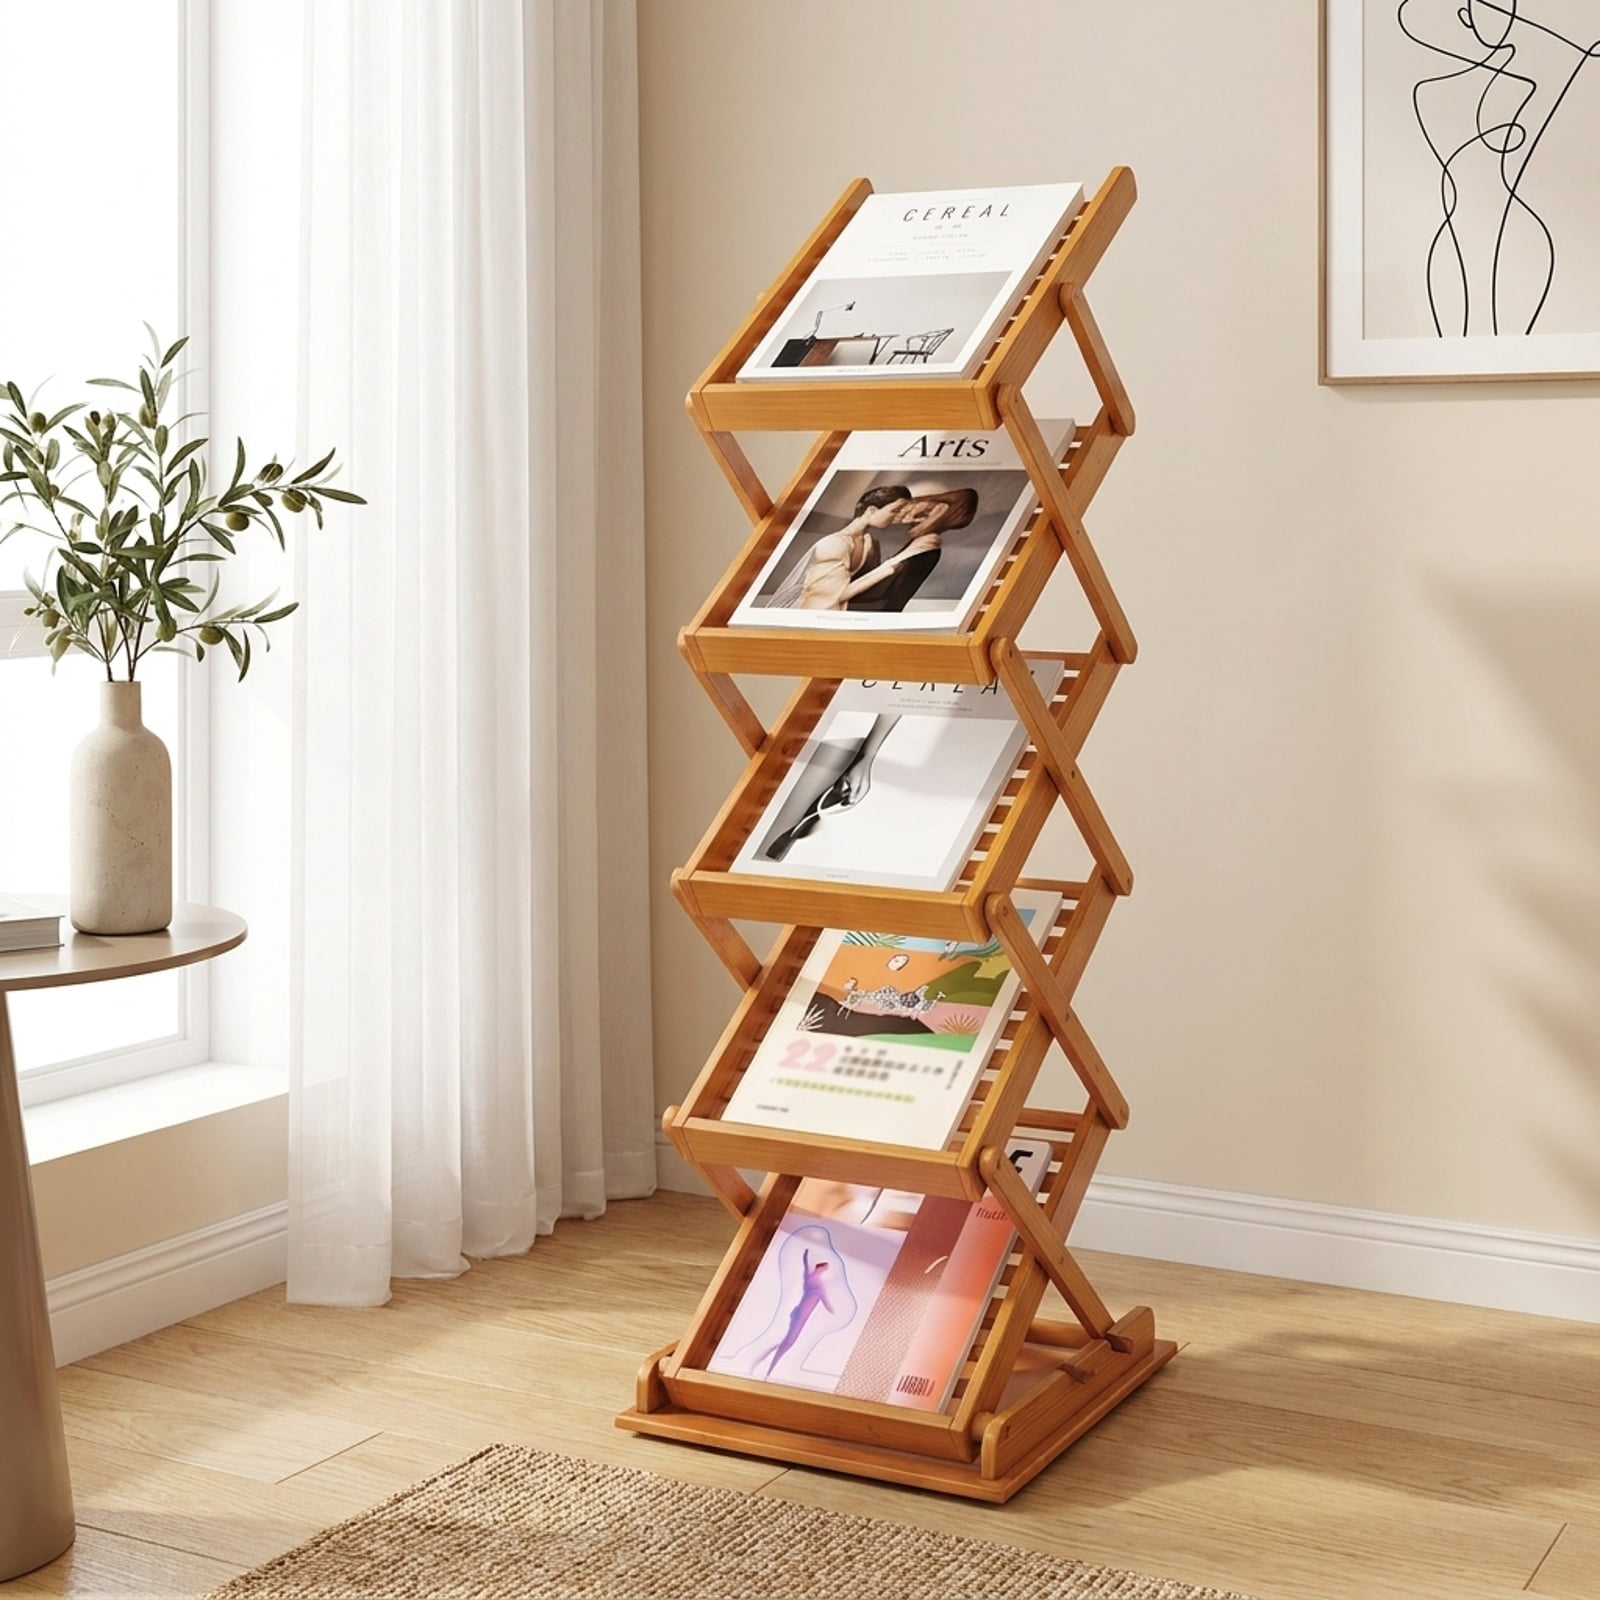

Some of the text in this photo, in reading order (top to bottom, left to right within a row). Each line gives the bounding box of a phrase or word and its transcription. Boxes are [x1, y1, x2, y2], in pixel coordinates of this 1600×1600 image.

[902, 203, 1011, 223] CEREAL
[897, 434, 990, 459] Arts
[777, 1038, 839, 1073] 22
